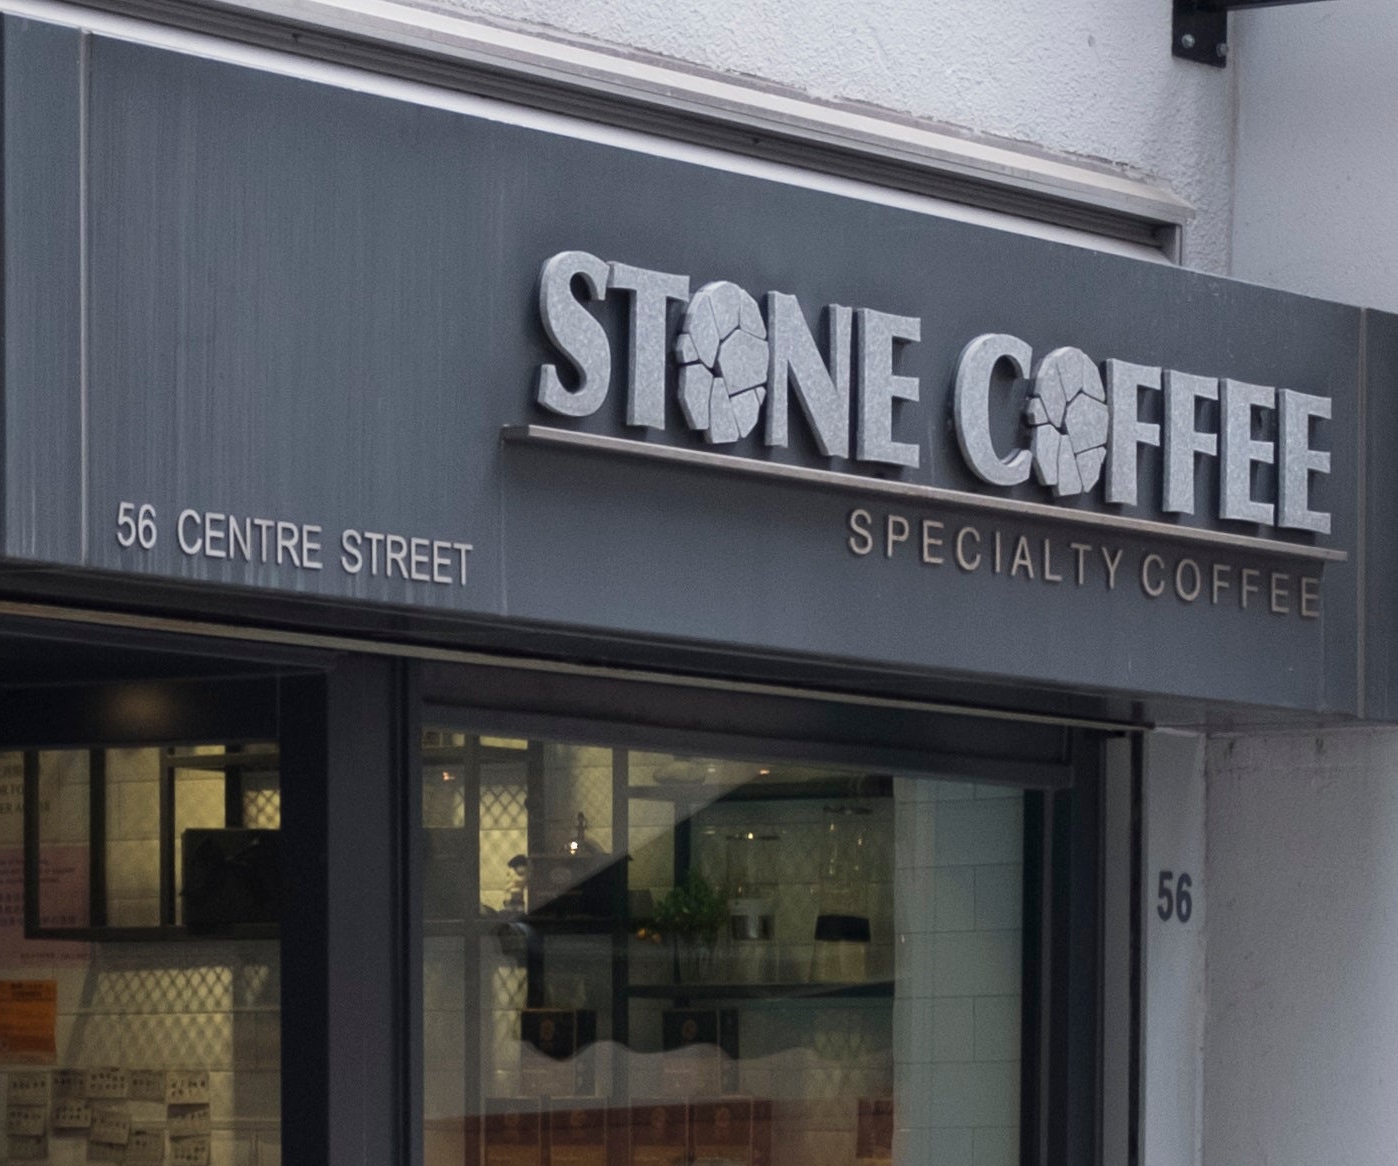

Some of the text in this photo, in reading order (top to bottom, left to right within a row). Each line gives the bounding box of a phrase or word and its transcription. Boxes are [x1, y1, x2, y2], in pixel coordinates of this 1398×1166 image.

[537, 249, 1332, 534] STONE COFFEE
[116, 501, 473, 586] 56 CENTRE STREET
[849, 507, 1321, 619] SPECIALTY COFFEE
[1156, 870, 1193, 923] 56
